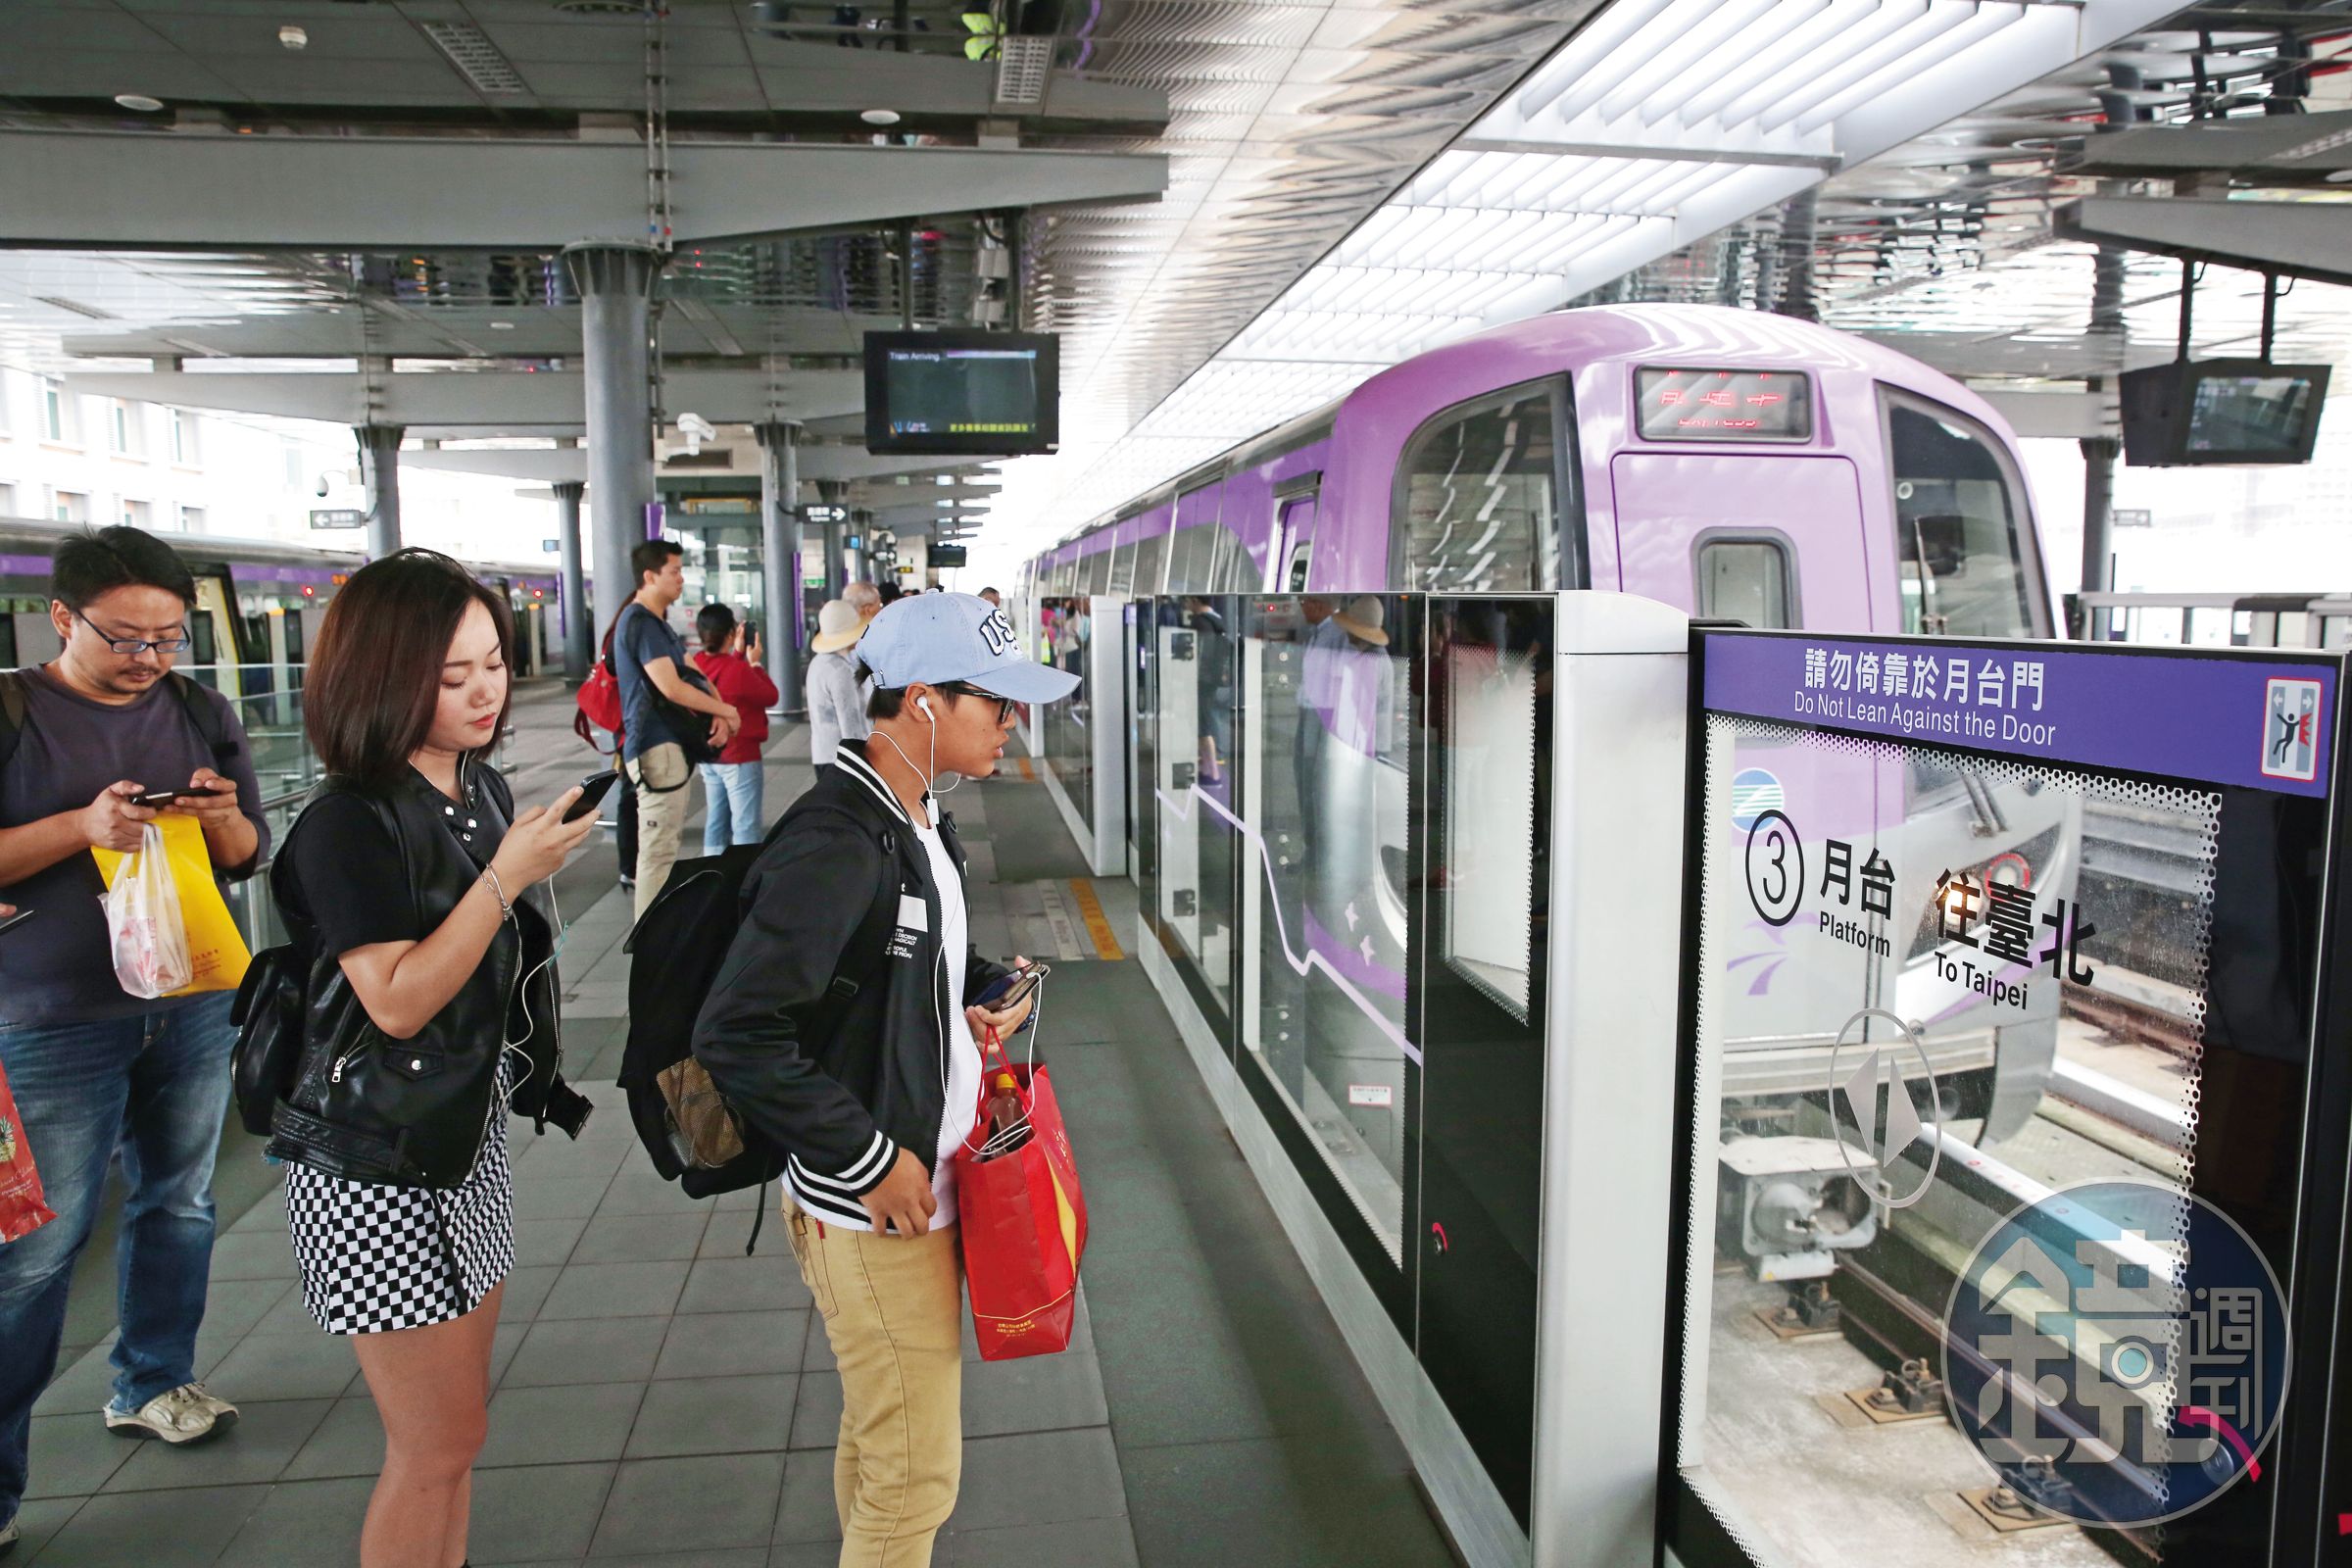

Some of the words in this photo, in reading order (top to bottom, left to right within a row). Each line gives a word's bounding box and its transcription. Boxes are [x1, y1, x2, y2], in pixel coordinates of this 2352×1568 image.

[890, 351, 909, 361] Train
[1805, 648, 2044, 711] 請勿倚靠於月台門
[1794, 691, 1813, 713] Do
[1818, 694, 1843, 718] Not
[1847, 697, 1886, 723] Lean
[1890, 702, 1960, 733] Against
[1964, 709, 1996, 739] the
[2003, 714, 2056, 746] Door
[1820, 838, 1896, 921] 月台
[1819, 911, 1890, 958] Platform
[1935, 867, 2096, 987] 往臺北
[1935, 951, 1958, 983] To
[1962, 960, 2029, 1010] Taipei
